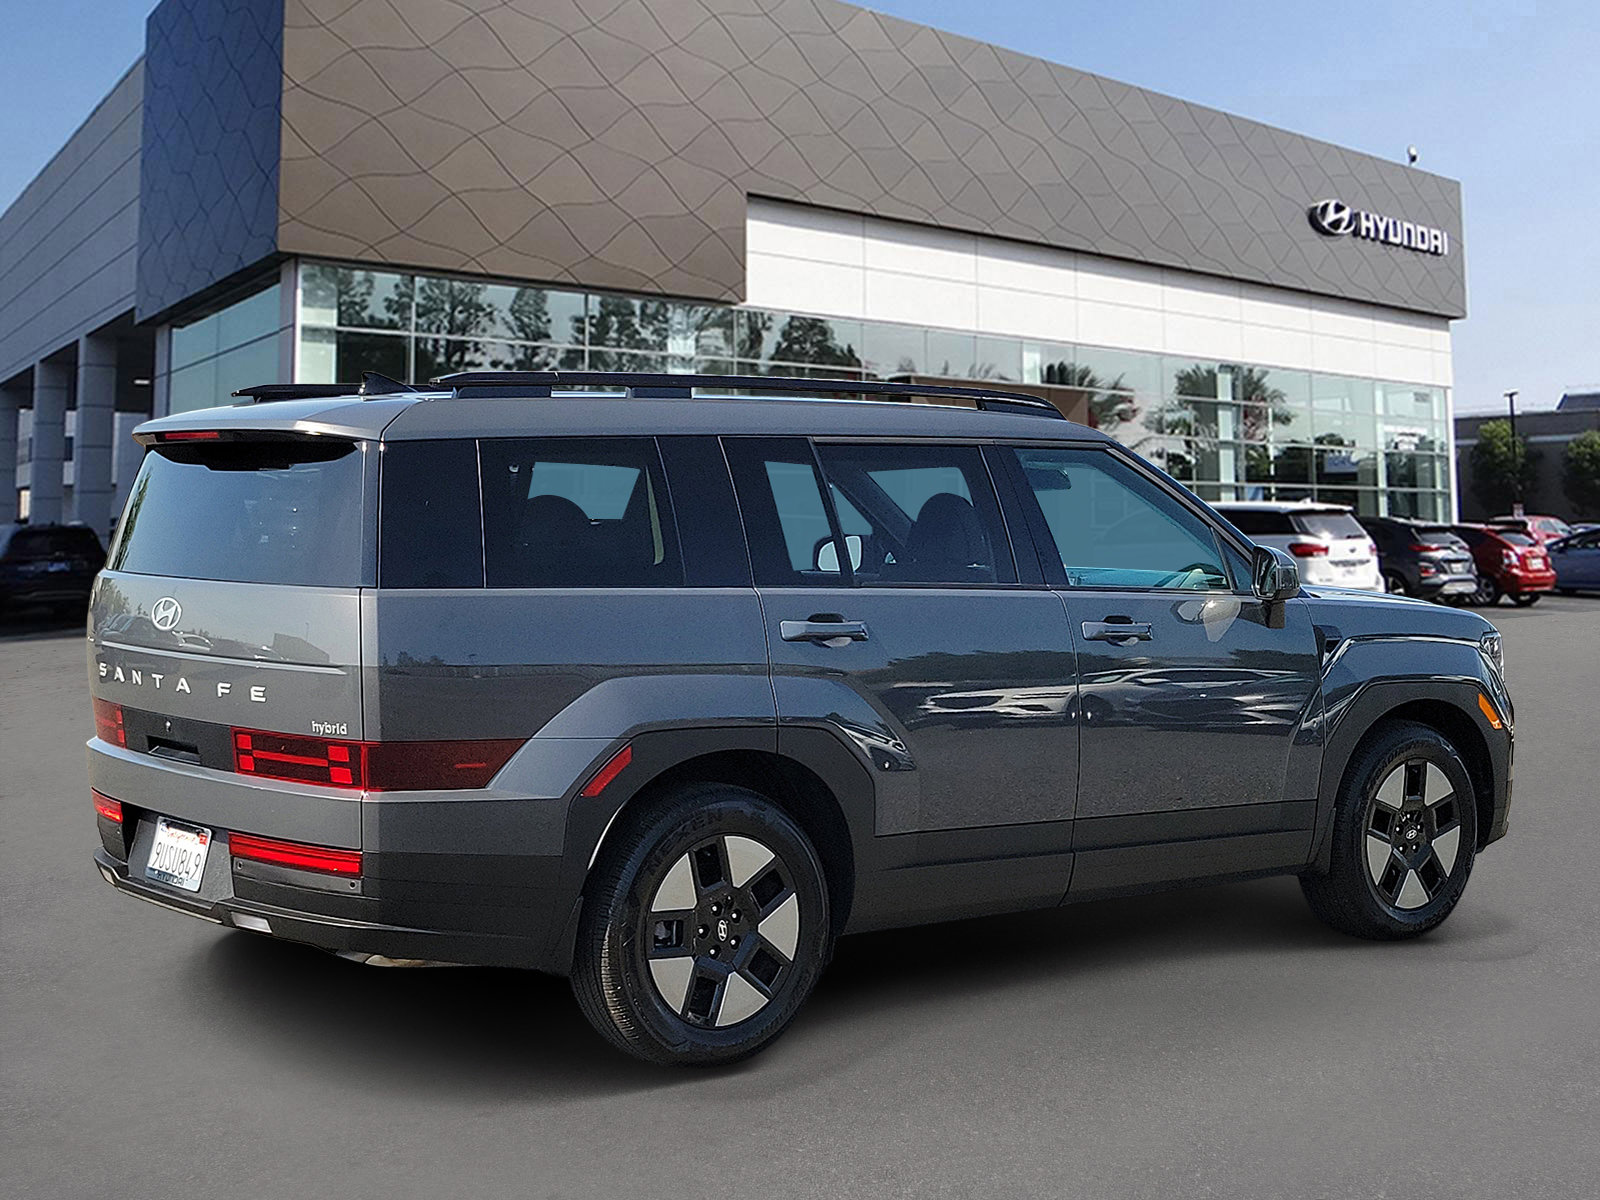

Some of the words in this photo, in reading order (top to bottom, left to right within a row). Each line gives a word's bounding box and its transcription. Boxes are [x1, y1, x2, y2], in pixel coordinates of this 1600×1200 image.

[1361, 211, 1448, 256] HYUNDAI
[99, 662, 191, 694] SANTA
[217, 682, 266, 702] FE
[311, 720, 348, 735] hybrid
[152, 841, 201, 880] 9USU849
